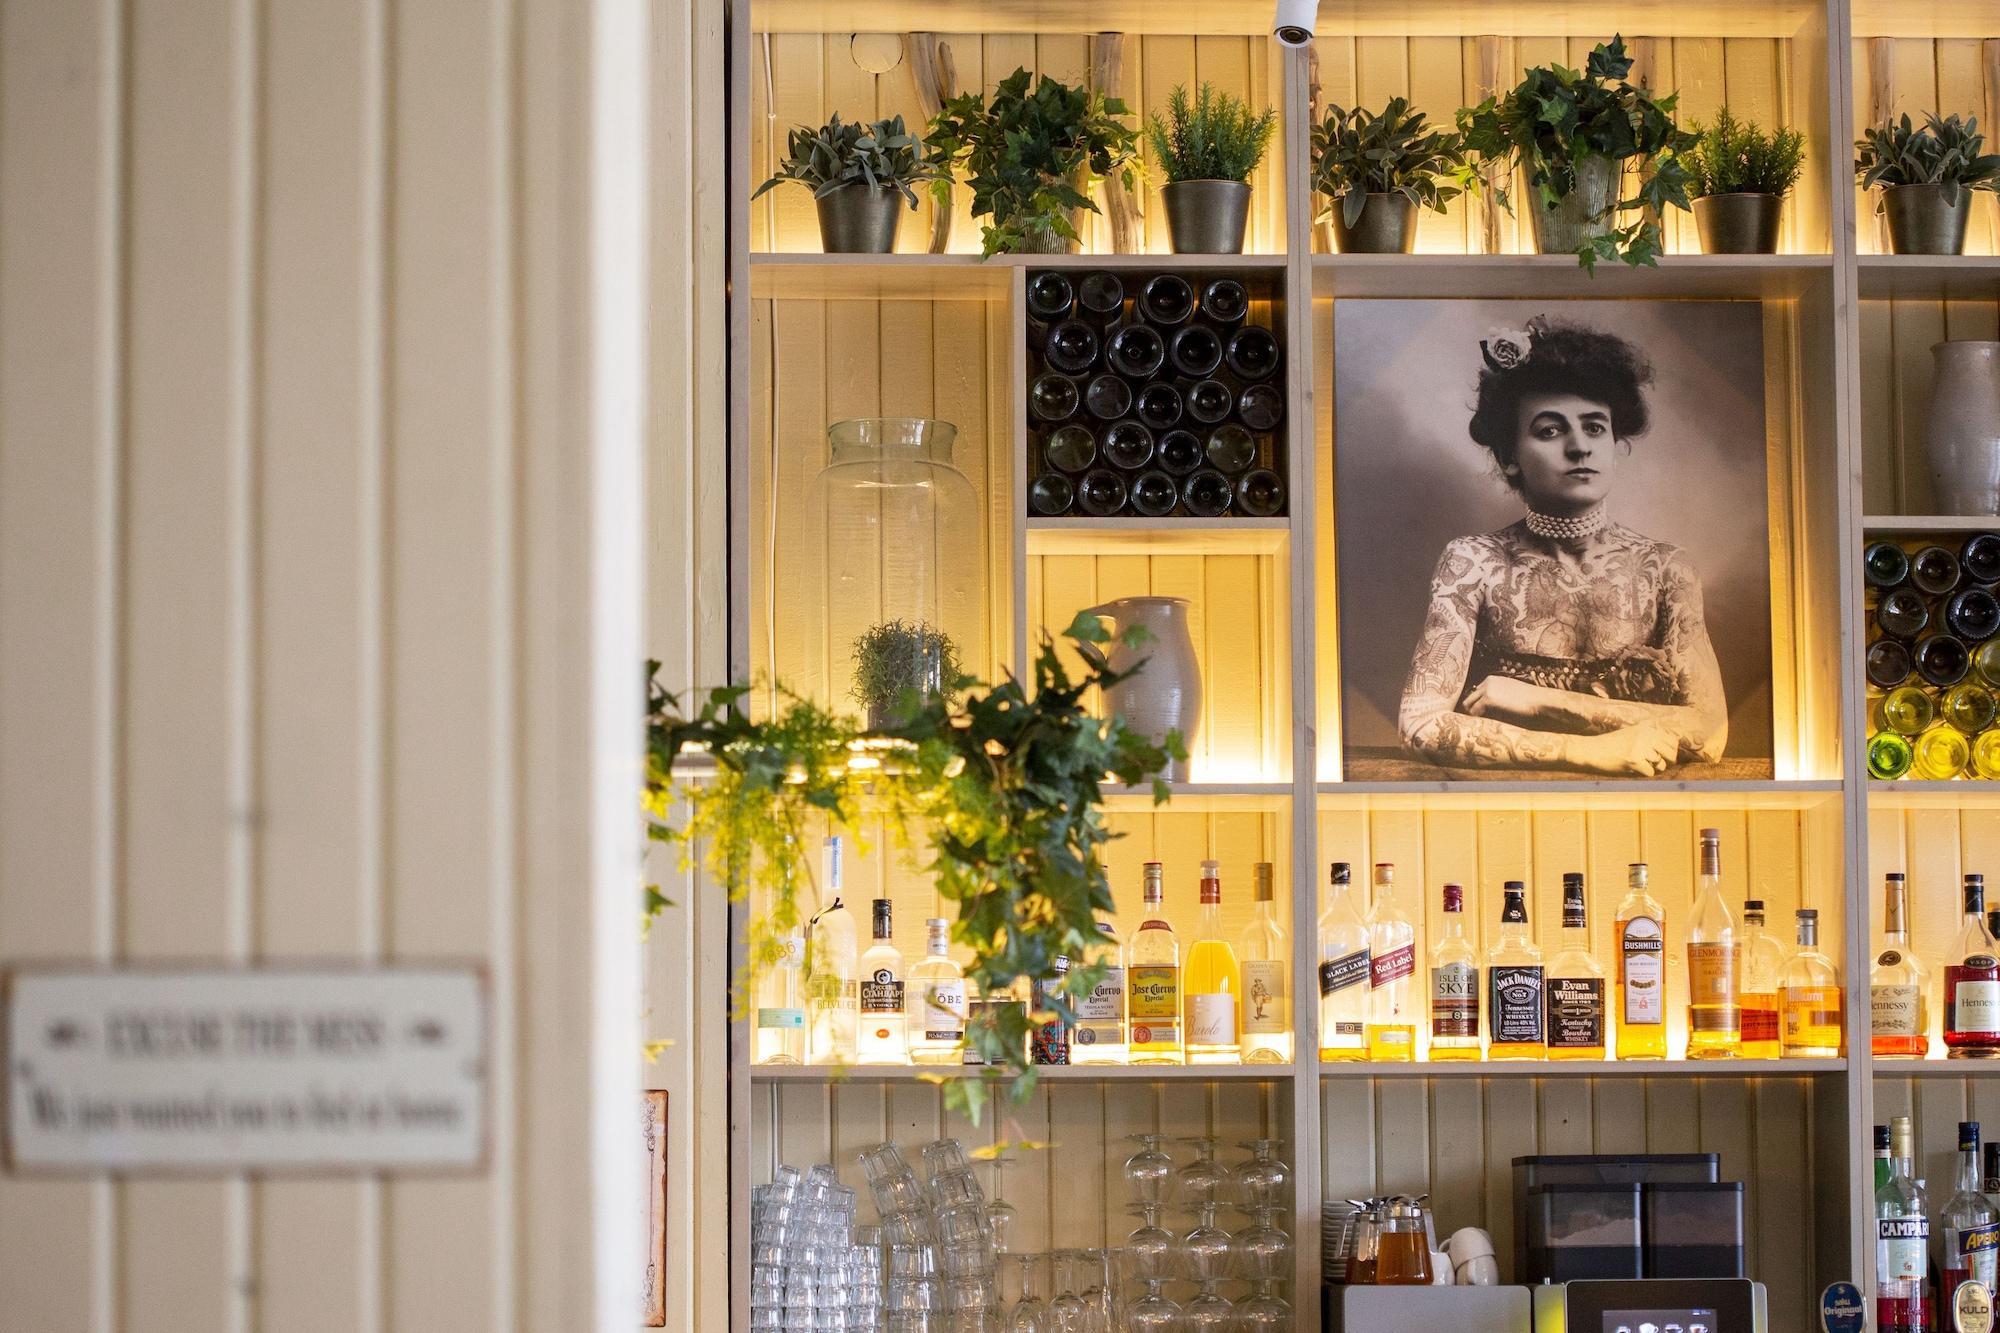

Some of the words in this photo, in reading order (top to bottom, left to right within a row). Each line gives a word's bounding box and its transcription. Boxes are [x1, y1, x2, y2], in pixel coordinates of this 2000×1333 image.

[1624, 941, 1662, 950] BUSHMILLS
[1326, 967, 1348, 980] BLACK
[1348, 958, 1370, 972] LABEL
[1374, 961, 1392, 975] Red
[1392, 953, 1414, 968] Label
[1439, 975, 1459, 983] ISLE
[1461, 975, 1473, 983] OF
[1496, 976, 1515, 991] JACK
[1514, 973, 1542, 990] DANIEL'S
[1094, 984, 1121, 997] Cuervo
[1131, 983, 1150, 996] Jose
[1150, 983, 1177, 996] Cuervo
[1439, 983, 1474, 994] SKYE
[1562, 980, 1590, 991] Evan
[937, 992, 962, 1004] ÕBE
[1554, 990, 1599, 1000] Williams
[1505, 1003, 1535, 1011] Tennessee
[1961, 998, 2000, 1008] Hennes
[1560, 1018, 1593, 1028] Kentucky
[1562, 1029, 1592, 1037] Bourbon
[1965, 1230, 2000, 1250] APERO
[1959, 1306, 1989, 1314] KULD
